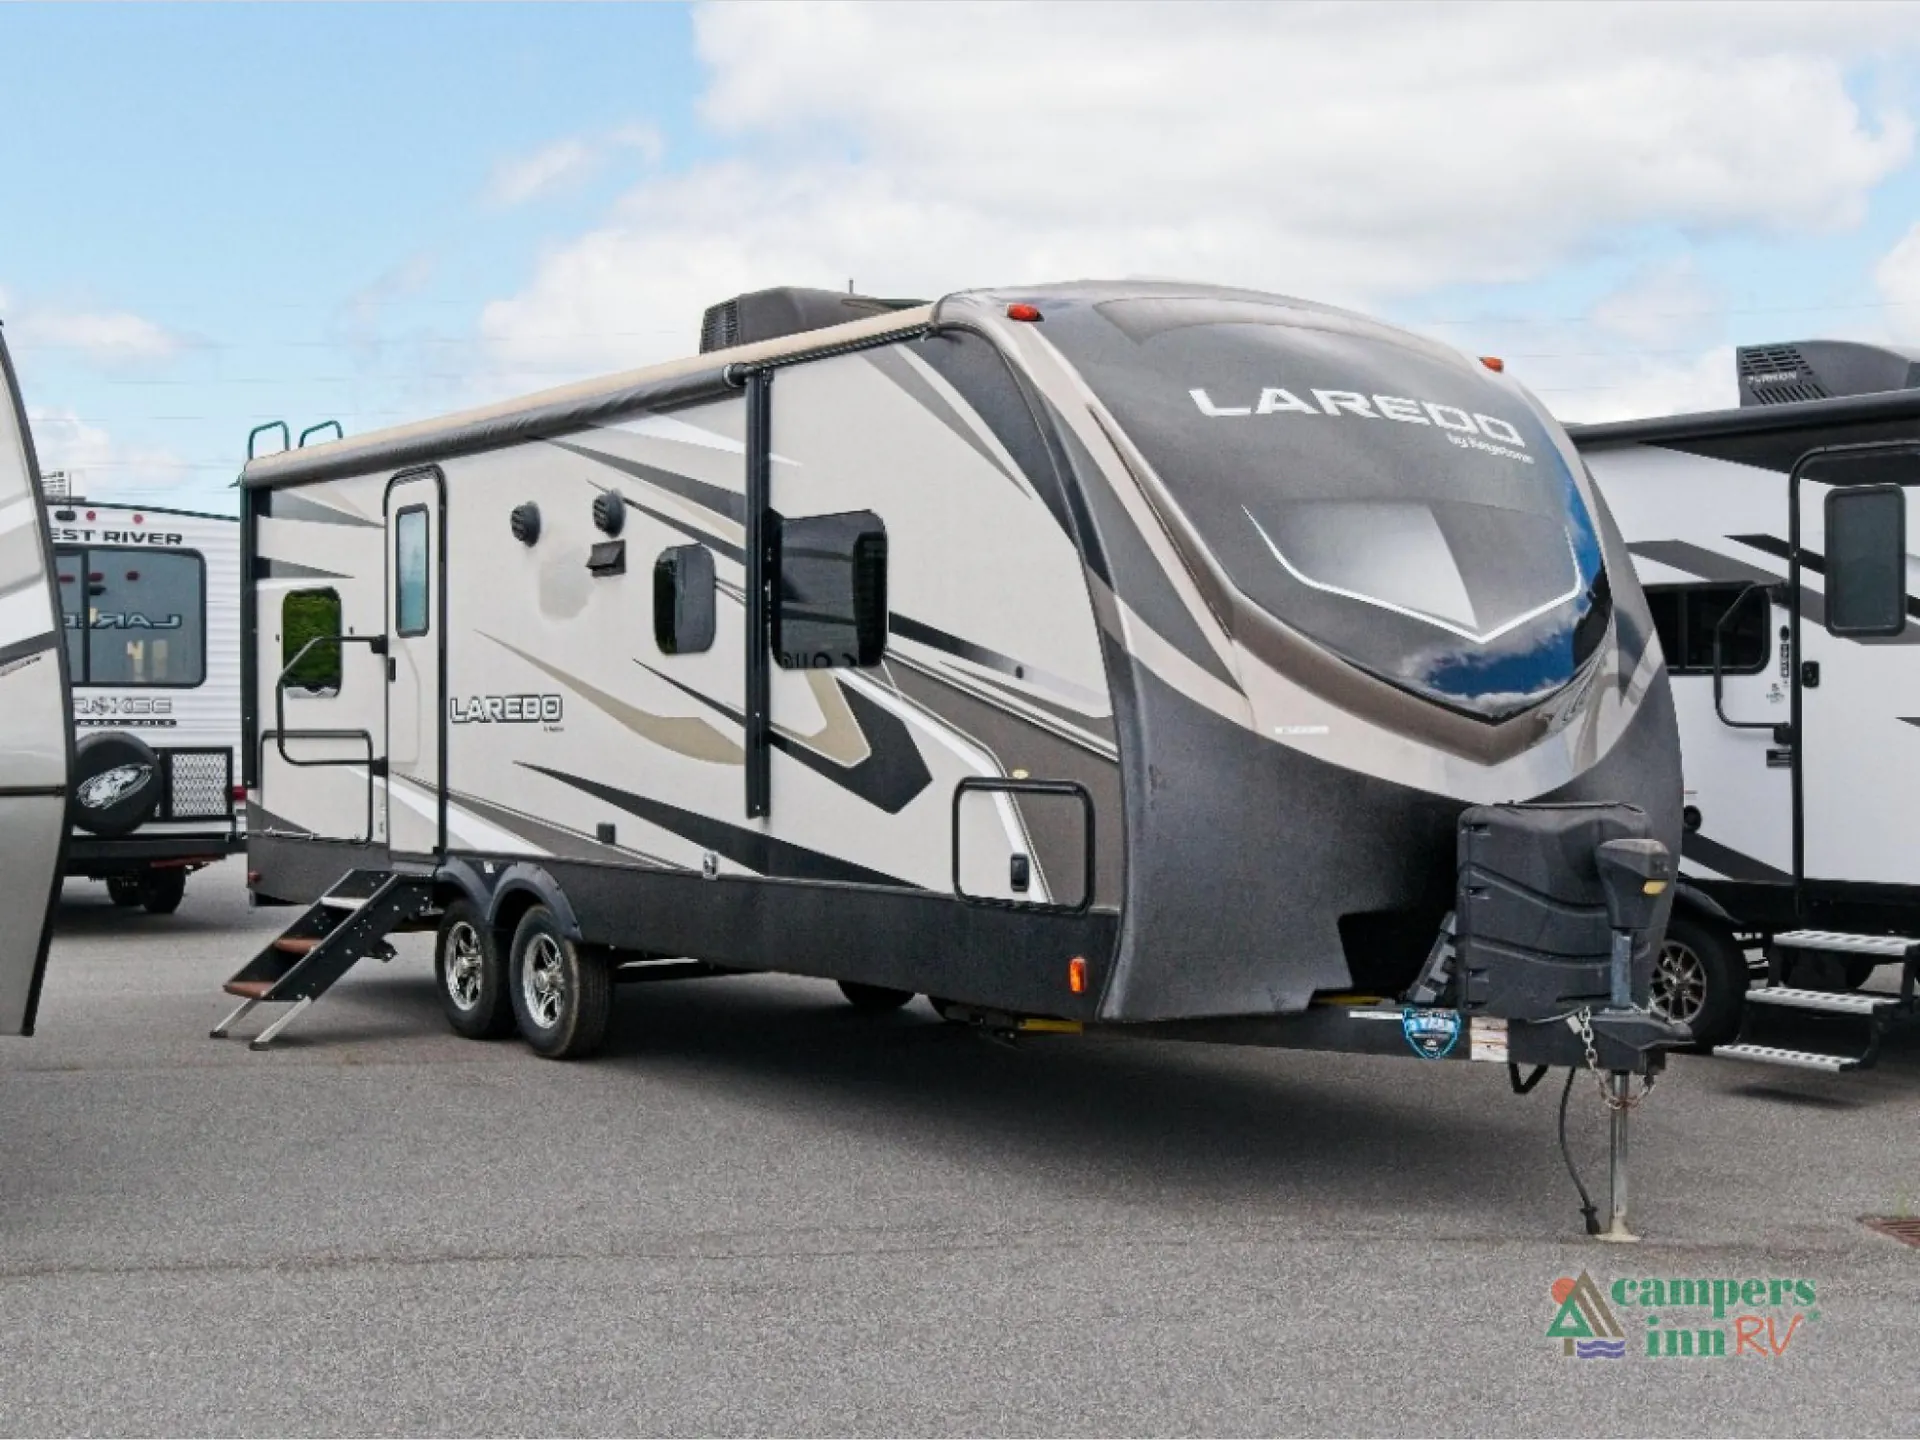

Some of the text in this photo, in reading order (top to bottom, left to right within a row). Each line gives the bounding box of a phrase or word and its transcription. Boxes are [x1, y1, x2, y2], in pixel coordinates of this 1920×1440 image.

[1189, 388, 1526, 449] LAREDO
[103, 531, 183, 545] RIVER
[450, 695, 562, 723] LAREDO
